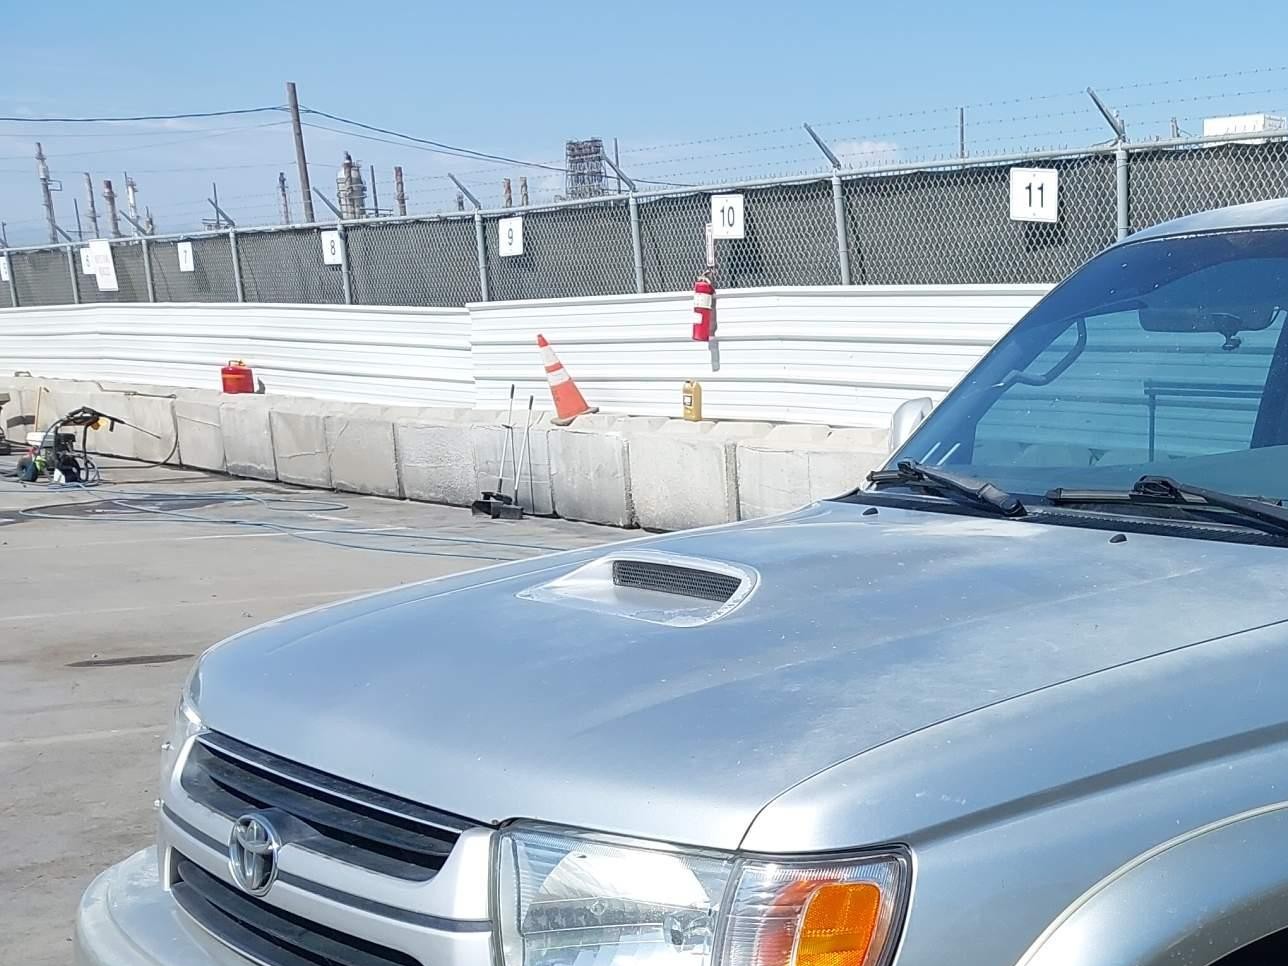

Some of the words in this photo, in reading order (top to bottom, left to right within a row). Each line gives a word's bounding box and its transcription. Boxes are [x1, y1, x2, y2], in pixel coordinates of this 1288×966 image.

[1024, 182, 1044, 209] 11
[720, 205, 735, 228] 10
[507, 227, 514, 247] 9
[183, 249, 188, 265] 7
[330, 239, 336, 256] 8
